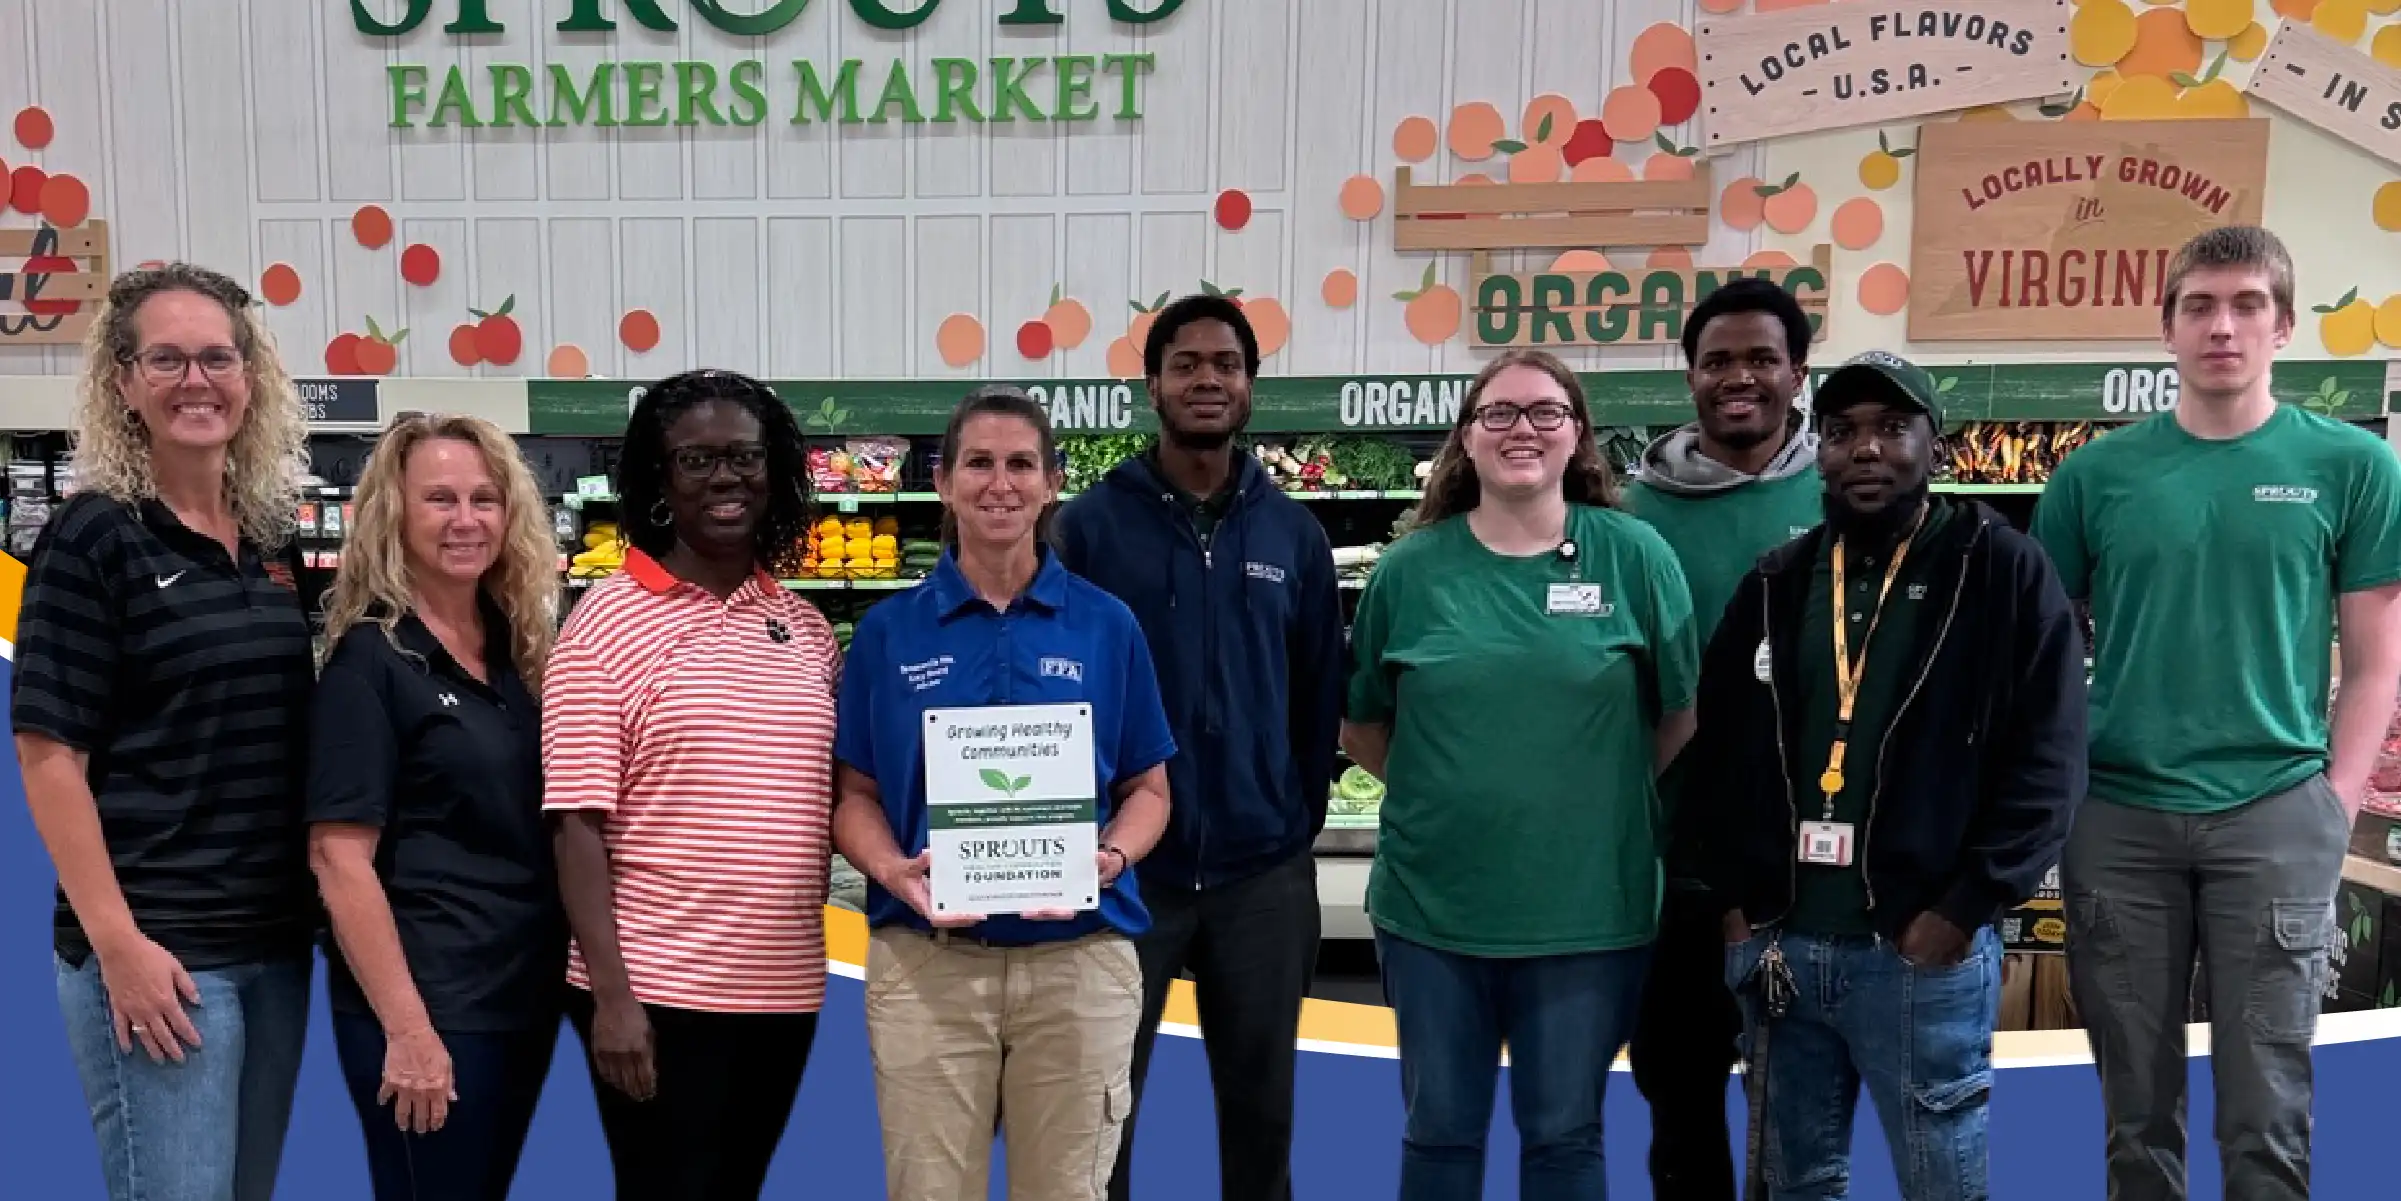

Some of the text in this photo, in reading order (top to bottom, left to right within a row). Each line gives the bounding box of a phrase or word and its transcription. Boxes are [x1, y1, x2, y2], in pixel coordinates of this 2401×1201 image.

[1740, 11, 2034, 96] LOCAL FLAVORS
[387, 52, 1155, 128] FARMERS MARKET
[1833, 63, 1941, 100] U.S.A.
[2323, 72, 2369, 113] IN
[2380, 101, 2401, 130] S
[1962, 155, 2231, 214] LOCALLY GROWN
[2075, 197, 2104, 221] in
[1963, 249, 2169, 307] VIRGINI
[1477, 266, 1826, 345] ORGAC
[1027, 384, 1132, 429] GANIC
[1340, 380, 1475, 427] ORGAN
[947, 720, 1073, 741] Growing Healthy
[960, 743, 1060, 760] Communities
[958, 837, 1066, 860] SPROUTS
[964, 868, 1063, 883] FOUNDATION
